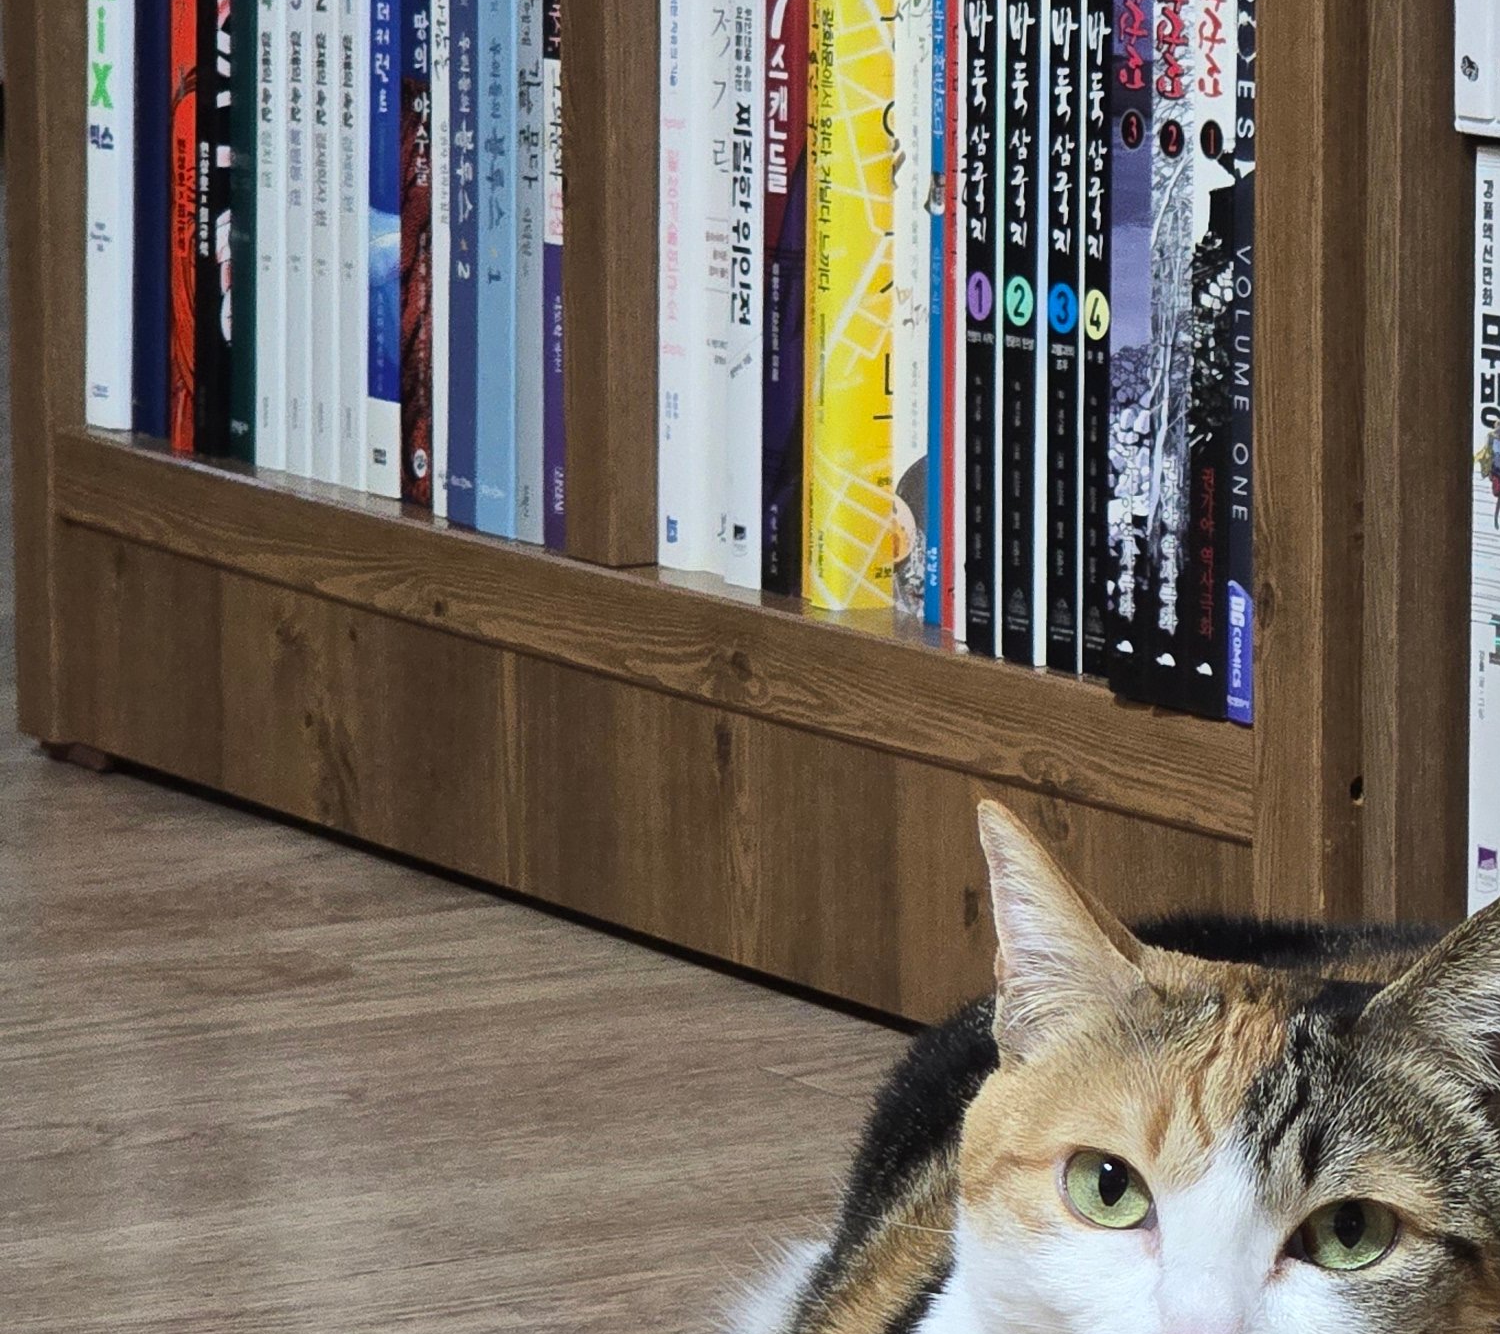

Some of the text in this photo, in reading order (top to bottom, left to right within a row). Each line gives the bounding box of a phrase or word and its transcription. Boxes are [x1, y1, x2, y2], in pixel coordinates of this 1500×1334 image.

[412, 92, 430, 187] 야수들
[453, 120, 475, 224] 블루스
[816, 7, 835, 293] 광화문에서 읽다 거닐다 느끼다
[969, 124, 991, 244] 삼국지
[731, 100, 754, 326] 찌질한 위인전
[1089, 297, 1102, 333] 4
[1231, 246, 1252, 522] VOLUME ONE
[1231, 597, 1245, 688] DC COMICS
